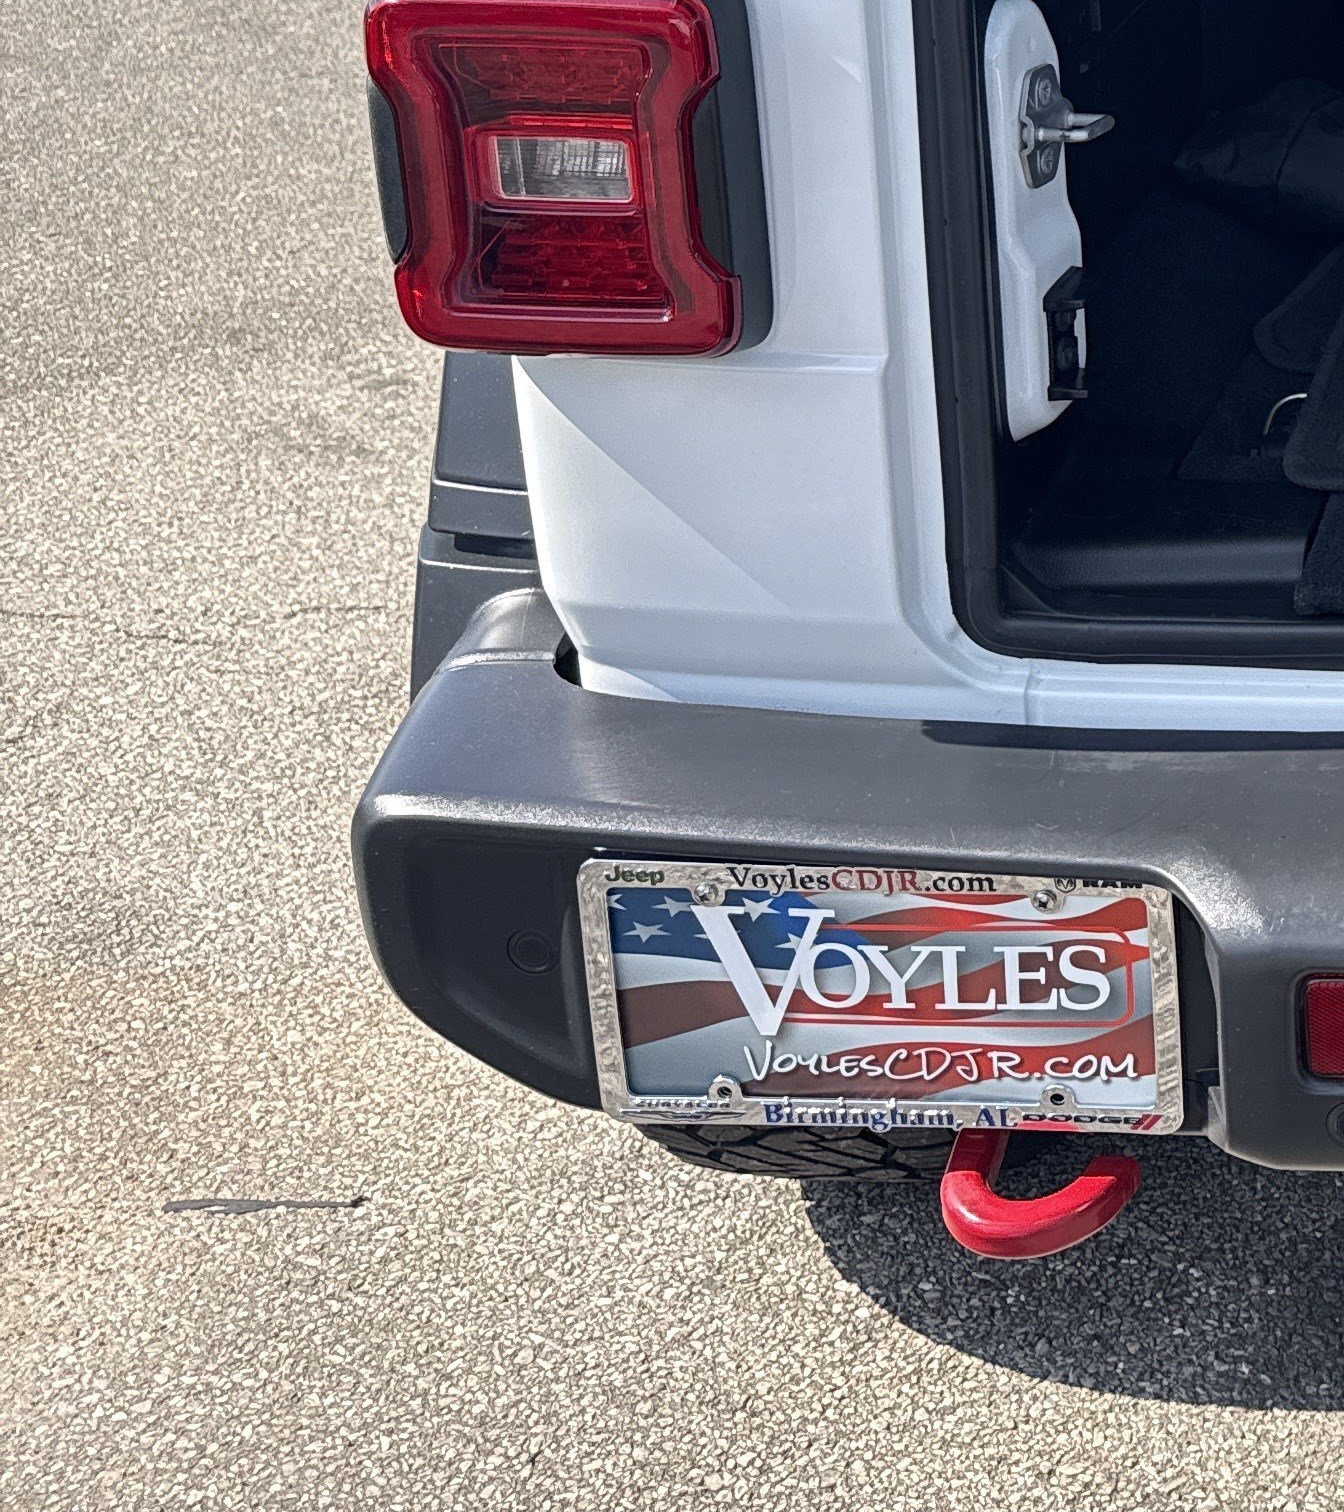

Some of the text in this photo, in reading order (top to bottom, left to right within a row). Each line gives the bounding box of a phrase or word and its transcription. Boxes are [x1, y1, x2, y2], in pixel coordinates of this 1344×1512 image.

[604, 864, 665, 886] Jeep
[726, 865, 997, 896] VoylesCDJR.com
[690, 904, 1111, 1037] VOYLES
[764, 1099, 1018, 1133] Birmingham, AL
[1022, 1112, 1144, 1125] DODGE
